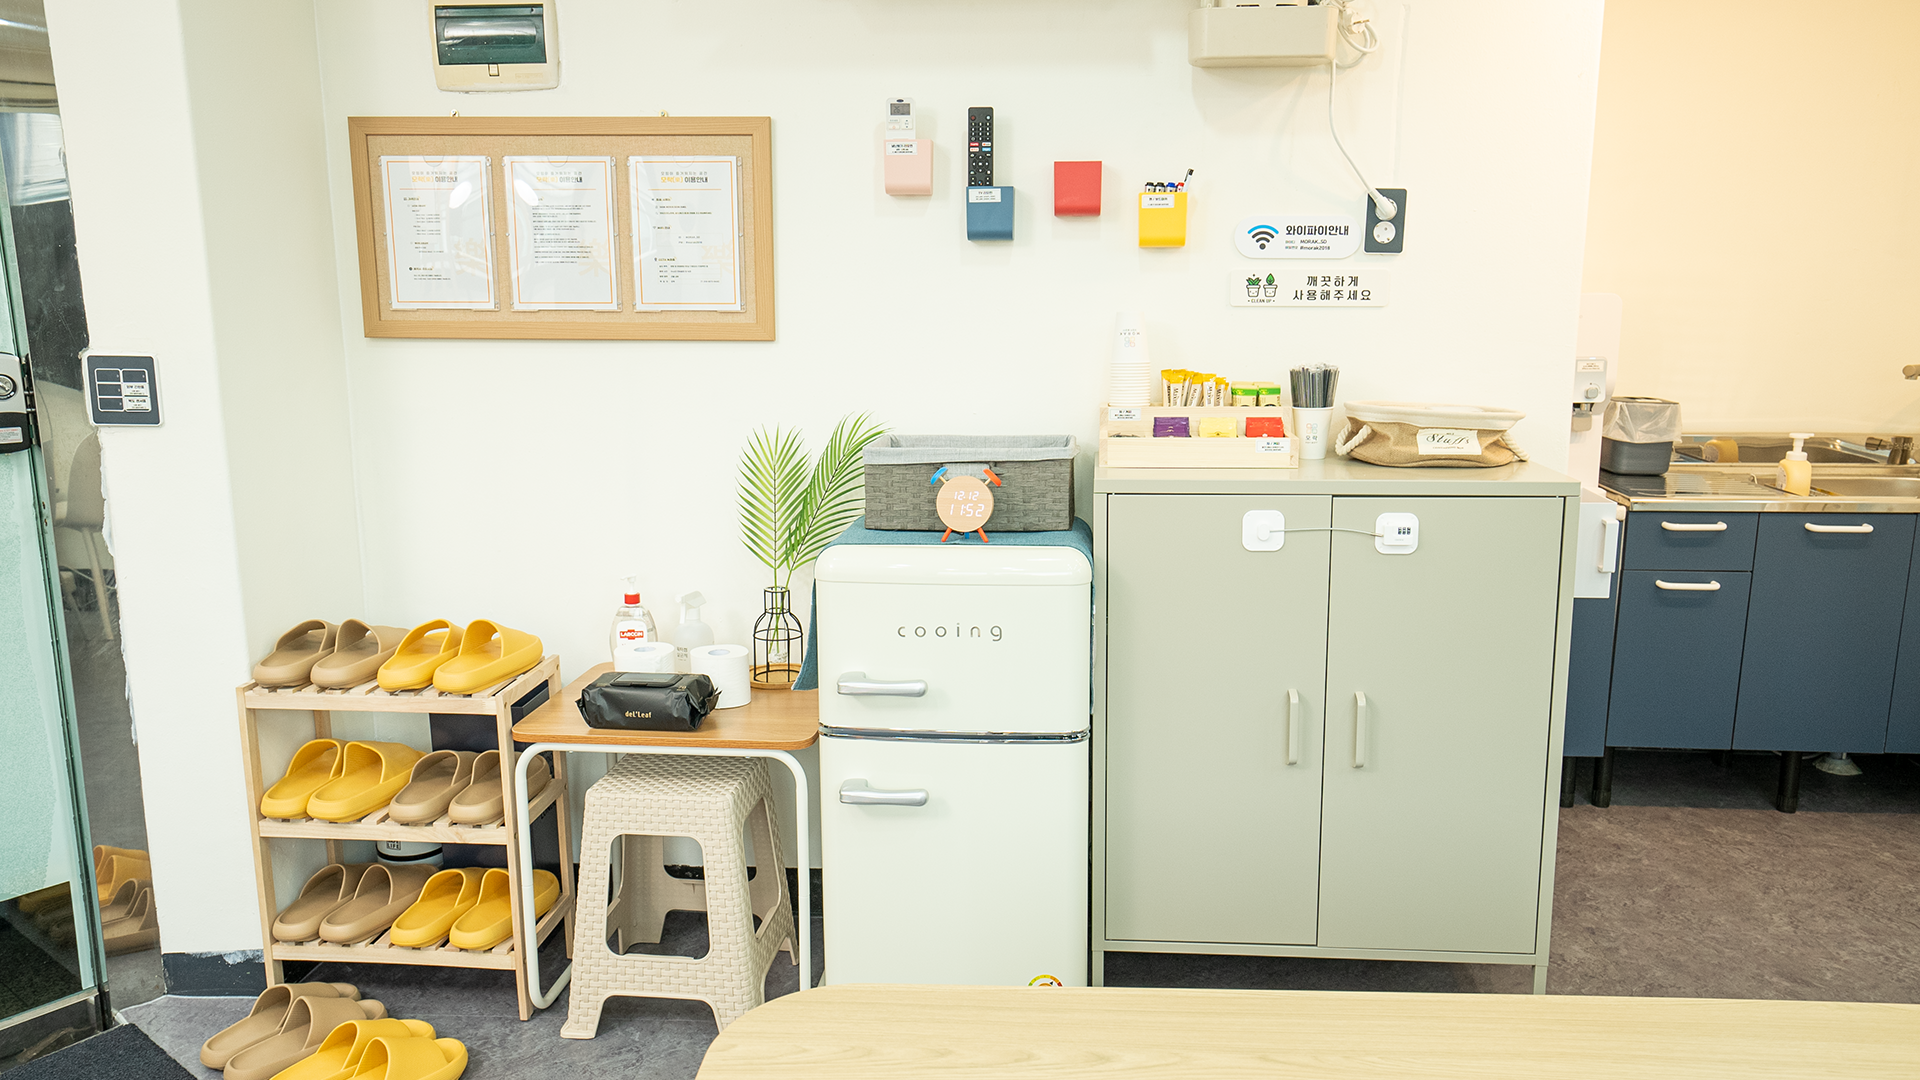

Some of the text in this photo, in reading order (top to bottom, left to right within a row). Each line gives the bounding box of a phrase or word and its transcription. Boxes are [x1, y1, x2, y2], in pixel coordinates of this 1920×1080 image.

[1286, 224, 1350, 236] 와이파이안내
[1306, 275, 1359, 287] 깨끗하게
[1292, 290, 1372, 301] 사용해주세요
[1426, 432, 1470, 446] Stuffs
[950, 503, 985, 517] 11:52
[897, 622, 1004, 642] cooing
